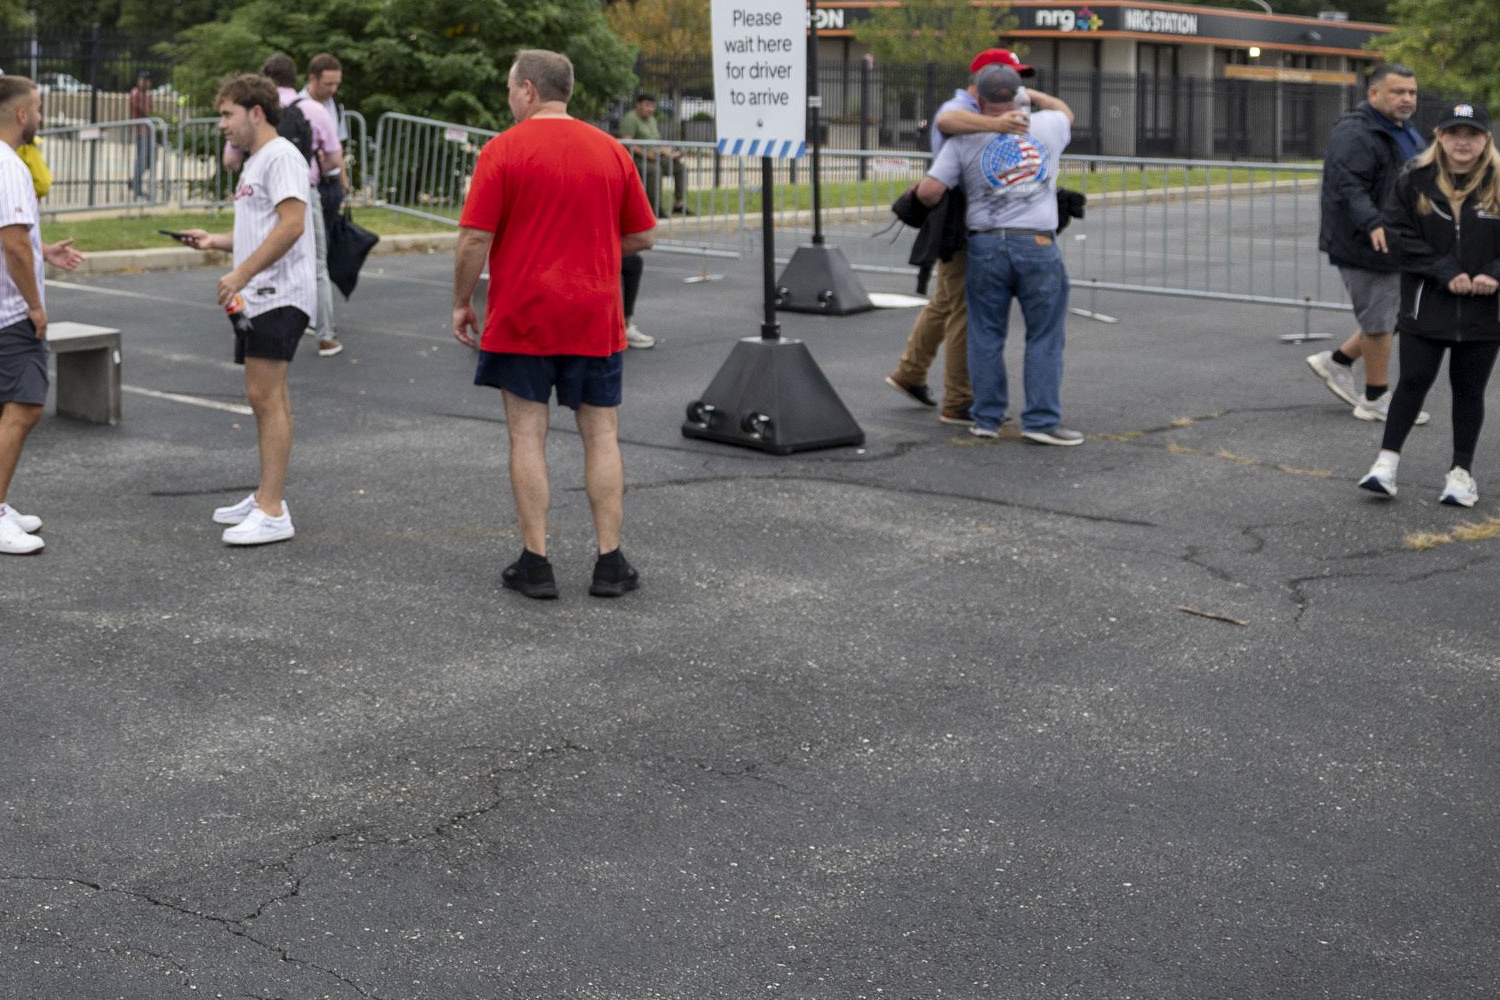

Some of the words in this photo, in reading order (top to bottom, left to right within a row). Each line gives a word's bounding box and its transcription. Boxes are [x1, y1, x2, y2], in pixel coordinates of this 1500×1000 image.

[732, 9, 782, 27] Please
[1035, 9, 1075, 32] nrg
[1124, 8, 1151, 31] NRG
[1152, 10, 1198, 35] STATION
[725, 36, 754, 53] wait
[757, 35, 793, 52] here
[725, 61, 746, 80] for
[749, 61, 793, 80] driver
[731, 90, 746, 105] to
[750, 87, 789, 105] arrive
